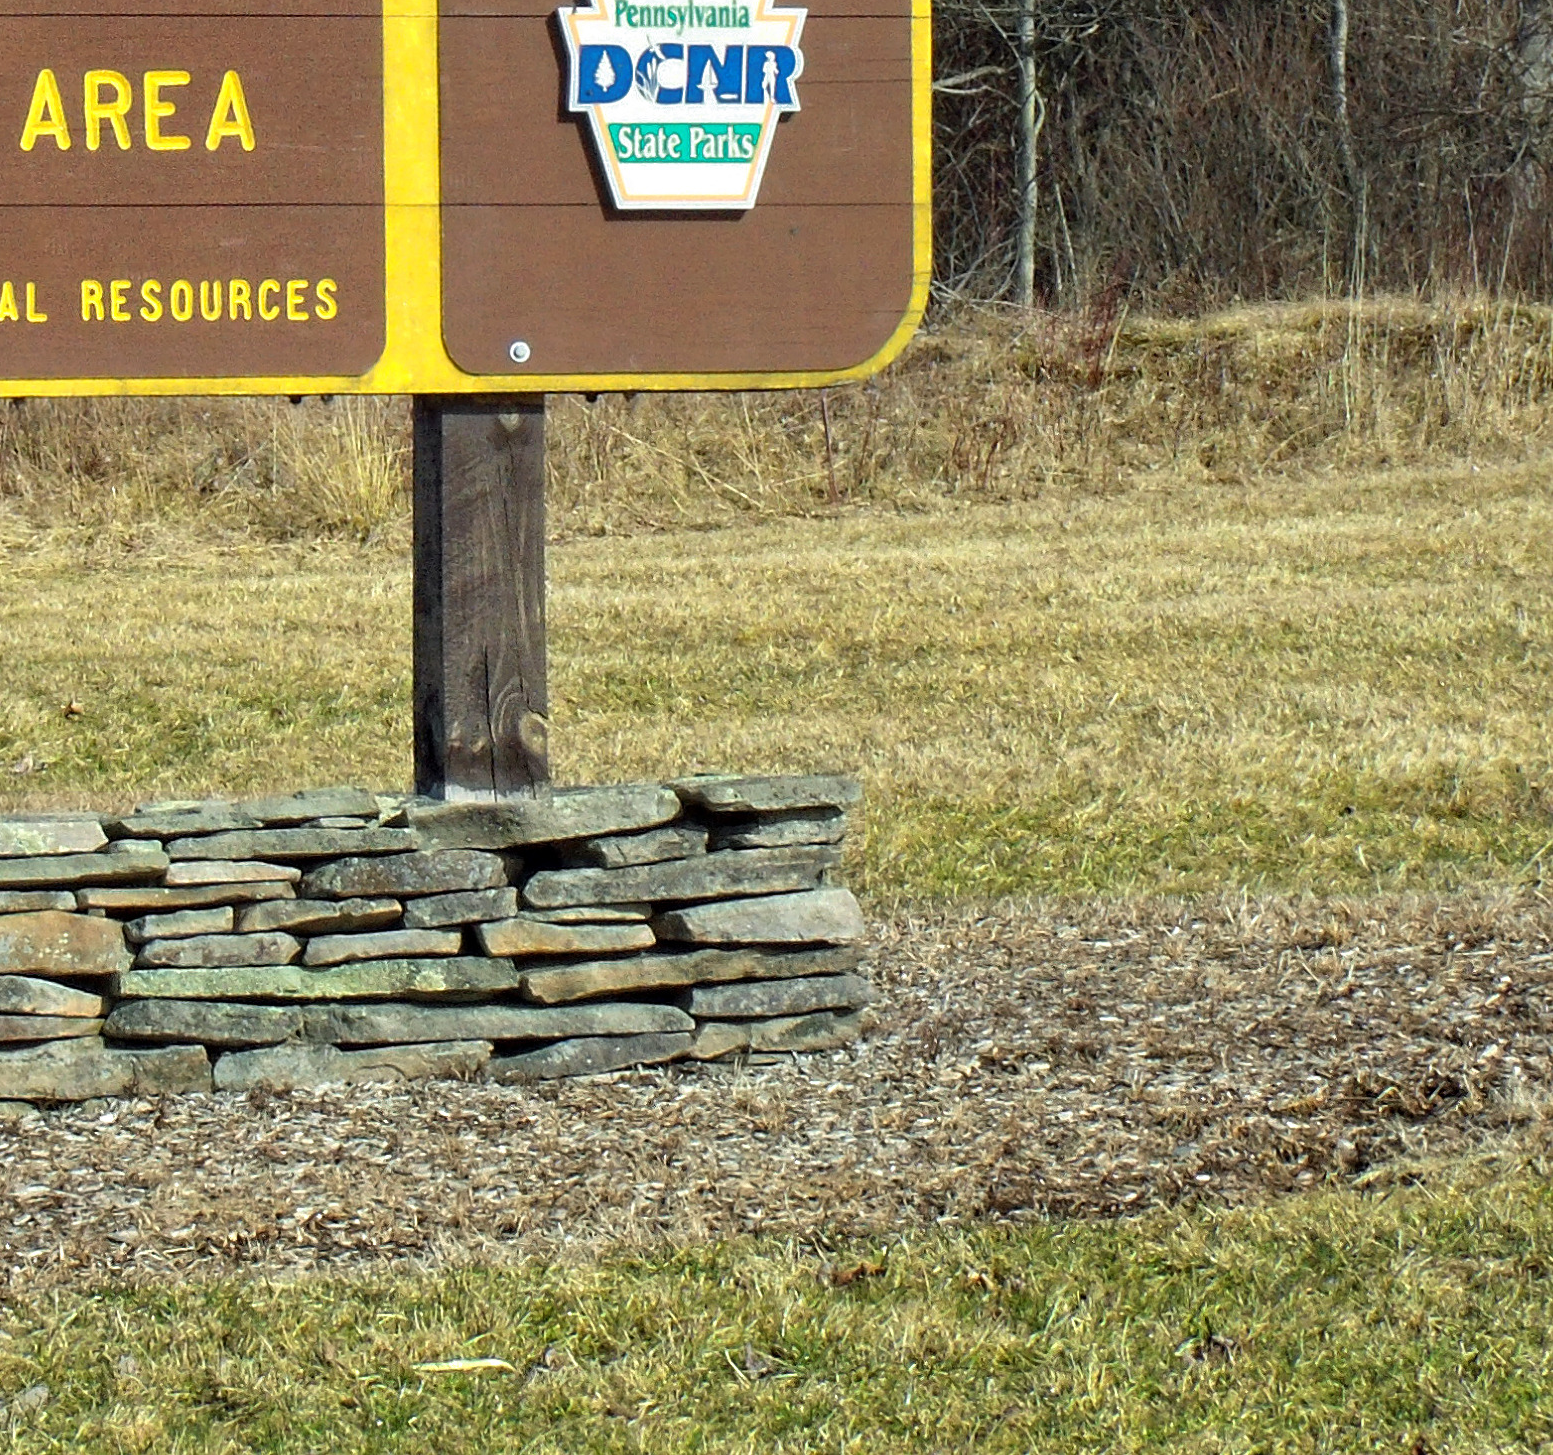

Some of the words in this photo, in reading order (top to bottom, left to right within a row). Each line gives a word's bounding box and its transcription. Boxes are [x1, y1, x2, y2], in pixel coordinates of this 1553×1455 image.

[578, 43, 796, 104] DCNR
[19, 68, 256, 152] AREA
[617, 126, 681, 159] State
[689, 126, 754, 159] Parks
[80, 278, 338, 322] RESOURCES
